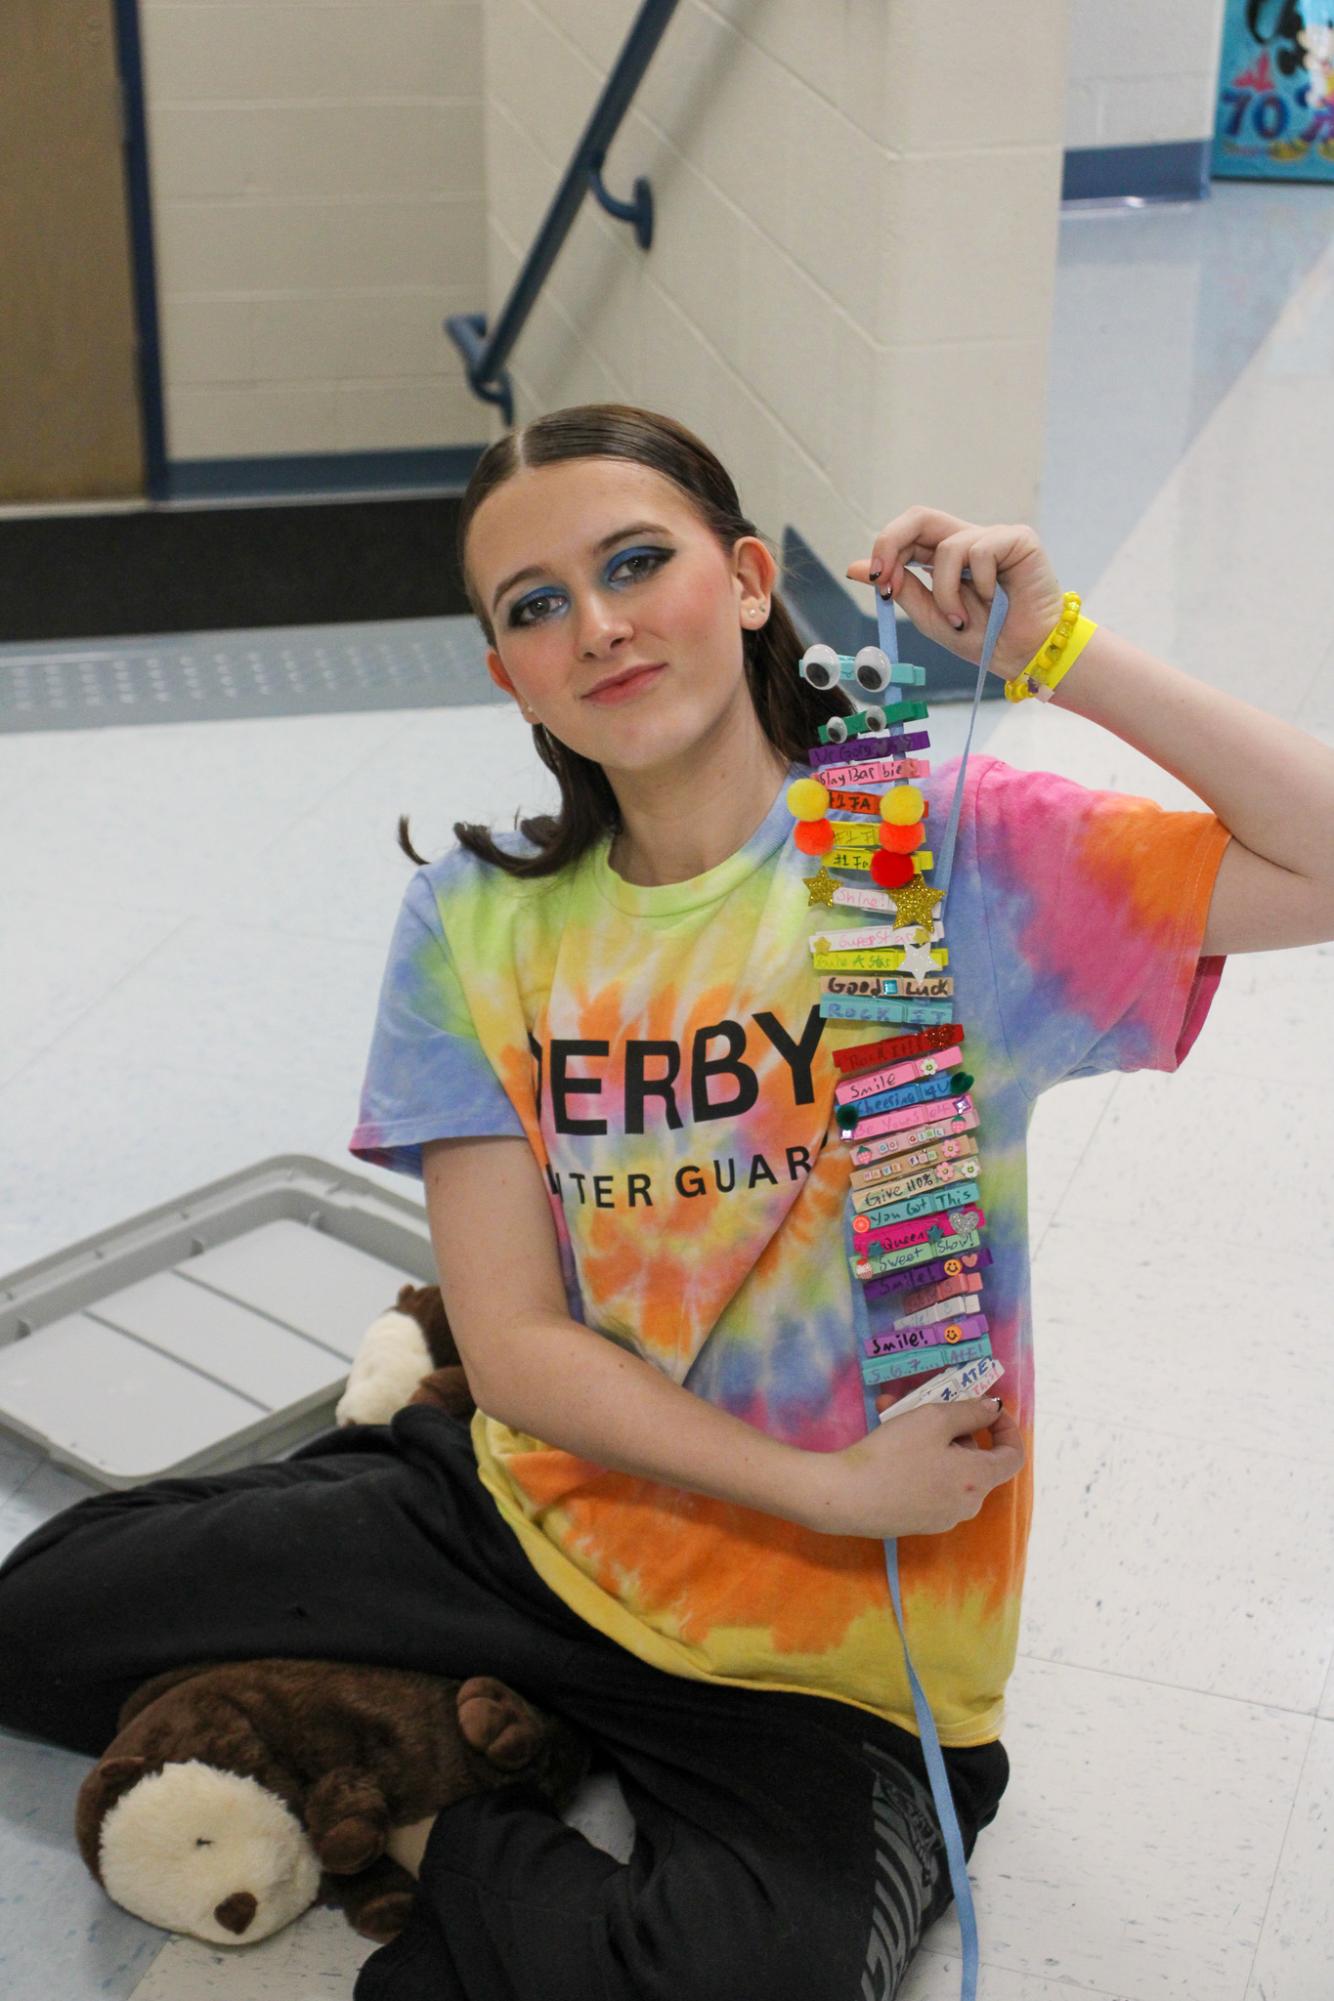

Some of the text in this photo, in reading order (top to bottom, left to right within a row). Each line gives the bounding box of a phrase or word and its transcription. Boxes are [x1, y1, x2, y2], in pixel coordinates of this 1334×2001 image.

[828, 977, 882, 996] Good
[850, 1073, 897, 1099] Smile
[545, 1138, 822, 1209] NTER GUAR
[864, 1184, 904, 1208] Give
[935, 1189, 972, 1208] This
[879, 1247, 923, 1272] Sweet
[872, 1330, 929, 1354] Smile!
